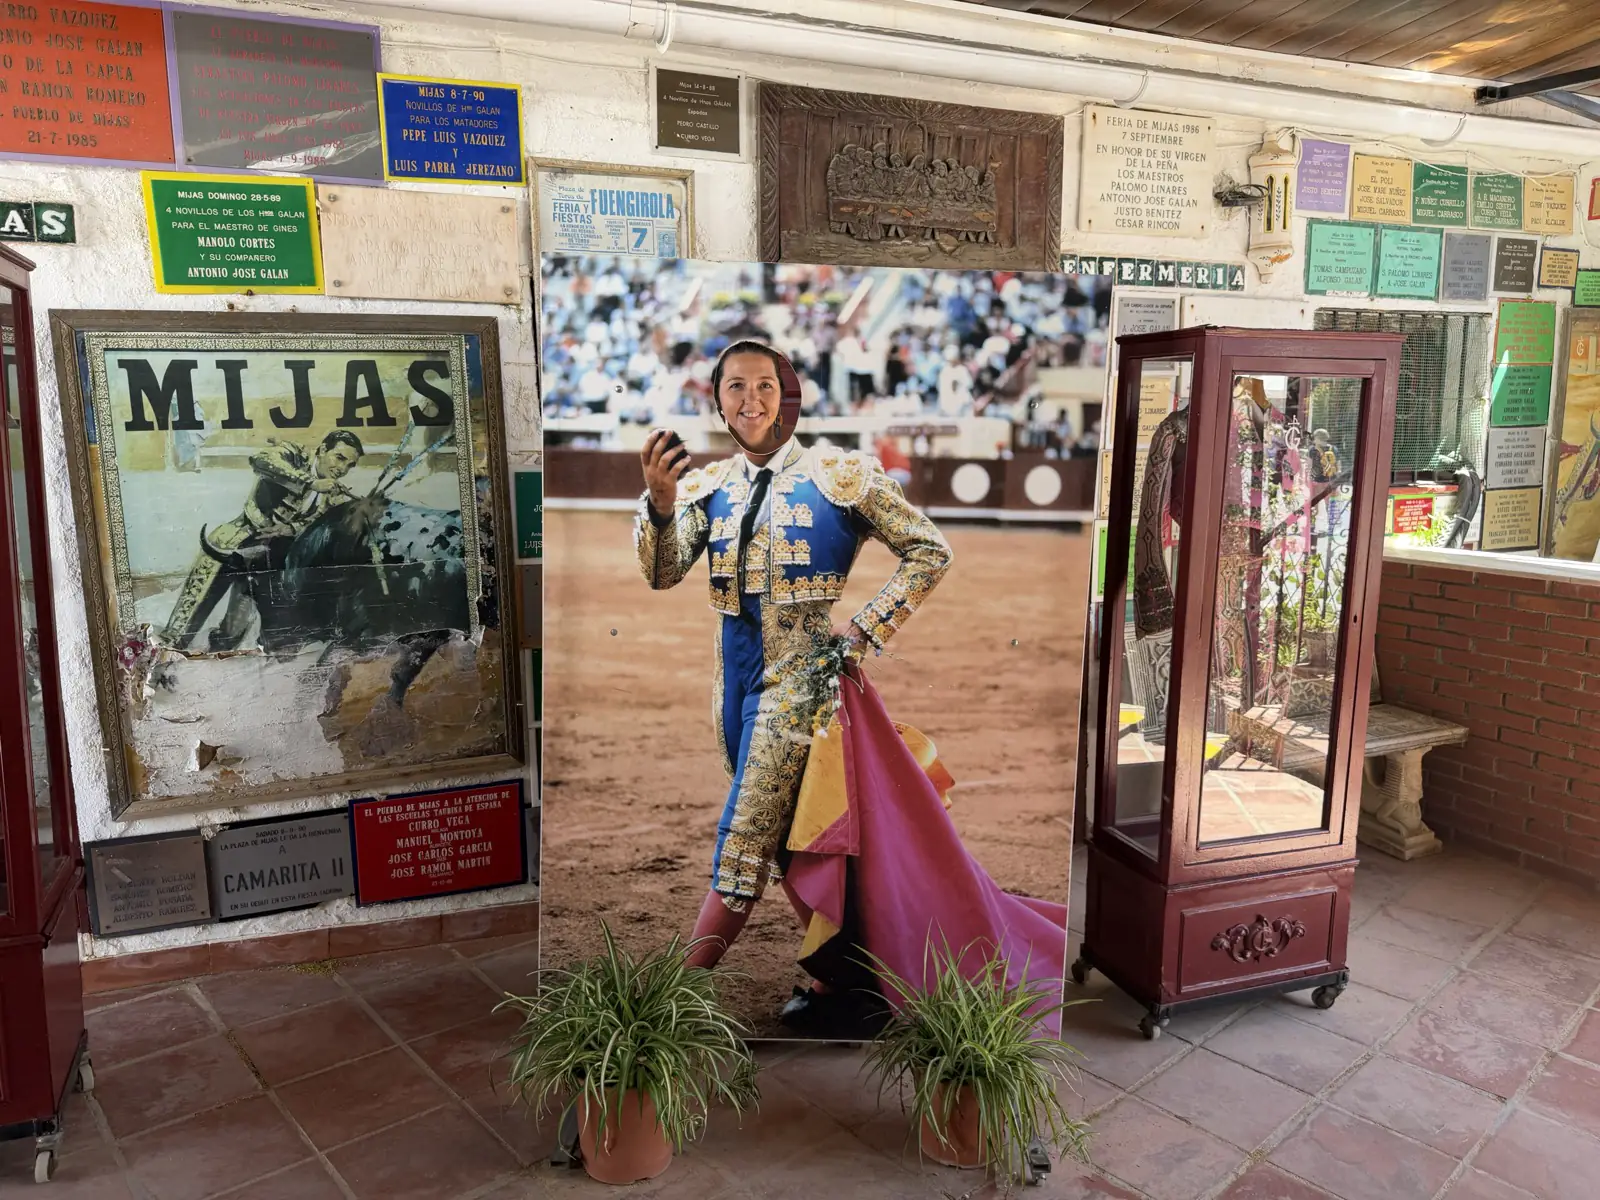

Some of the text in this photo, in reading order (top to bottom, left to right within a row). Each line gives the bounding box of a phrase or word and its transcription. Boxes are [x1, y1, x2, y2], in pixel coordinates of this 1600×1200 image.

[50, 8, 118, 30] VAZQUEZ
[46, 33, 143, 57] JOSE GALAN
[26, 57, 73, 75] DE LA
[21, 81, 146, 106] RAMON ROMERO
[418, 86, 485, 101] MIJAS 8-7-90
[669, 95, 689, 103] Novillos
[405, 100, 500, 115] NOVILLOS DE GALAN
[13, 106, 84, 124] PUEBLO DE
[410, 115, 498, 129] PARA LOS MATADORES
[676, 120, 720, 130] PEDRO CASTILLO
[1107, 116, 1179, 132] FERIA DE MIJAS
[402, 129, 506, 147] PEPE LUIS VAZQUEZ
[1122, 132, 1183, 145] 7 SEPTIEMBRE
[453, 148, 458, 158] Y
[1097, 144, 1206, 162] EN HONOR DE SU VIRGEN
[394, 160, 456, 174] LUIS PARRA
[1126, 158, 1178, 171] DE LA PEÑA
[1118, 169, 1184, 183] LOS MAESTROS
[1111, 181, 1187, 195] PALOMO LINARES
[1357, 184, 1371, 193] JOSE
[178, 191, 247, 201] MIJAS DOMINGO
[1100, 193, 1198, 207] ANTONIO JOSE GALAN
[1360, 196, 1403, 206] JOSE SALVADOR
[553, 202, 589, 214] FERIA Y
[590, 189, 674, 219] FUENGIROLA
[176, 207, 218, 216] NOVILLOS
[278, 211, 305, 219] GALAN
[1114, 207, 1182, 219] JUSTO BENITEZ
[1357, 206, 1405, 217] MIGUEL CARRASCO
[1416, 208, 1464, 219] MIGUEL CARRASCO
[552, 212, 592, 225] FIESTAS
[1116, 218, 1180, 230] CESAR RINCON
[172, 222, 298, 233] PARA EL MAESTRO DE GINES
[197, 236, 275, 249] MANOLO CORTES
[632, 227, 648, 248] 7
[188, 267, 289, 279] ANTONIO JOSE GALAN
[1062, 259, 1245, 286] ENFERMERIA
[1313, 264, 1367, 275] TOMAS CAMPUZANO
[1388, 270, 1433, 279] PALOMO LINARES
[1316, 276, 1362, 284] ALFONSO GALAN
[1393, 280, 1407, 288] JOSE
[1130, 325, 1146, 333] JOSE
[117, 358, 456, 431] MIJAS
[364, 791, 511, 817] EL PUEBLO DE MIJAS A LA ATENCION DE
[379, 804, 473, 824] LAS ESCUELAS DE
[409, 815, 470, 832] CURRO VEGA
[255, 829, 278, 838] SABADO
[396, 828, 483, 849] MANUEL MONTOYA
[260, 837, 278, 845] MIJAS
[279, 845, 286, 855] A
[387, 841, 492, 865] JOSE CARLOS GARCIA
[390, 855, 491, 879] JOSE RAMON MARTIN
[224, 857, 343, 894] CAMARITA II
[230, 903, 239, 911] EN
[281, 895, 296, 903] ESTA
[298, 891, 318, 900] FIESTA
[158, 903, 197, 916] RAMIREZ
